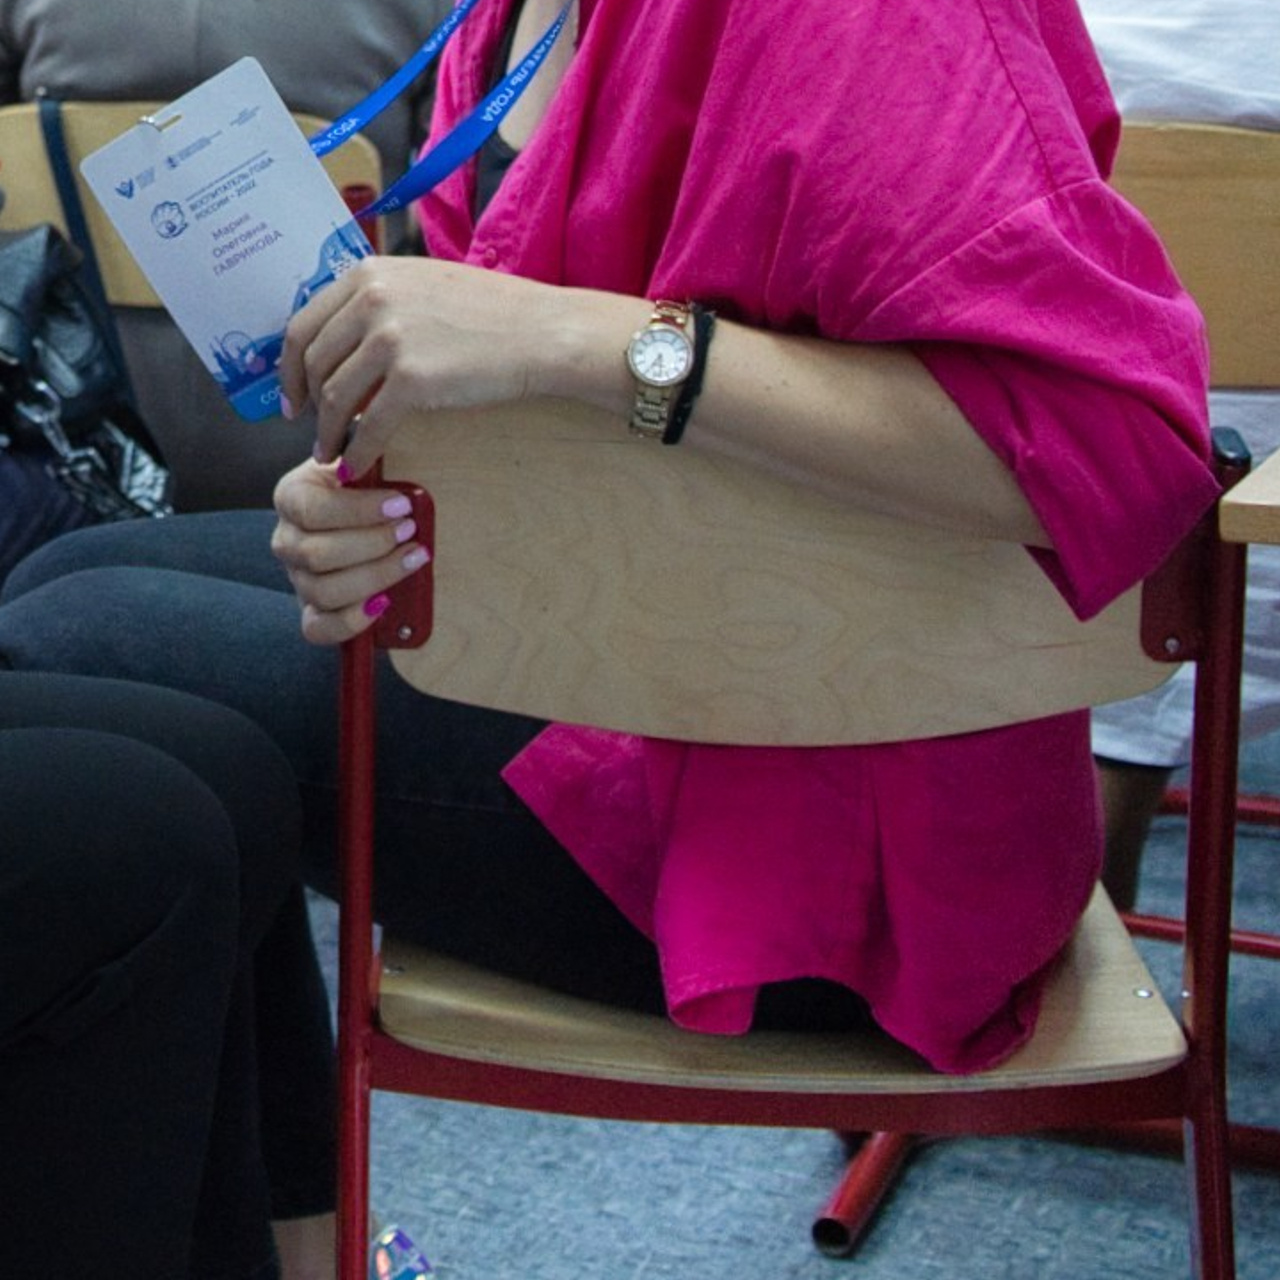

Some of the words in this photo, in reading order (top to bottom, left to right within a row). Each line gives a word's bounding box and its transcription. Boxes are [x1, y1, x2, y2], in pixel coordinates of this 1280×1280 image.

[481, 87, 515, 122] ГОДА
[189, 172, 250, 211] ВОСПИТАТЕЛЬ
[211, 213, 251, 241] Мария
[212, 222, 268, 259] Олеговна
[213, 230, 284, 277] ГАВРИКОВА
